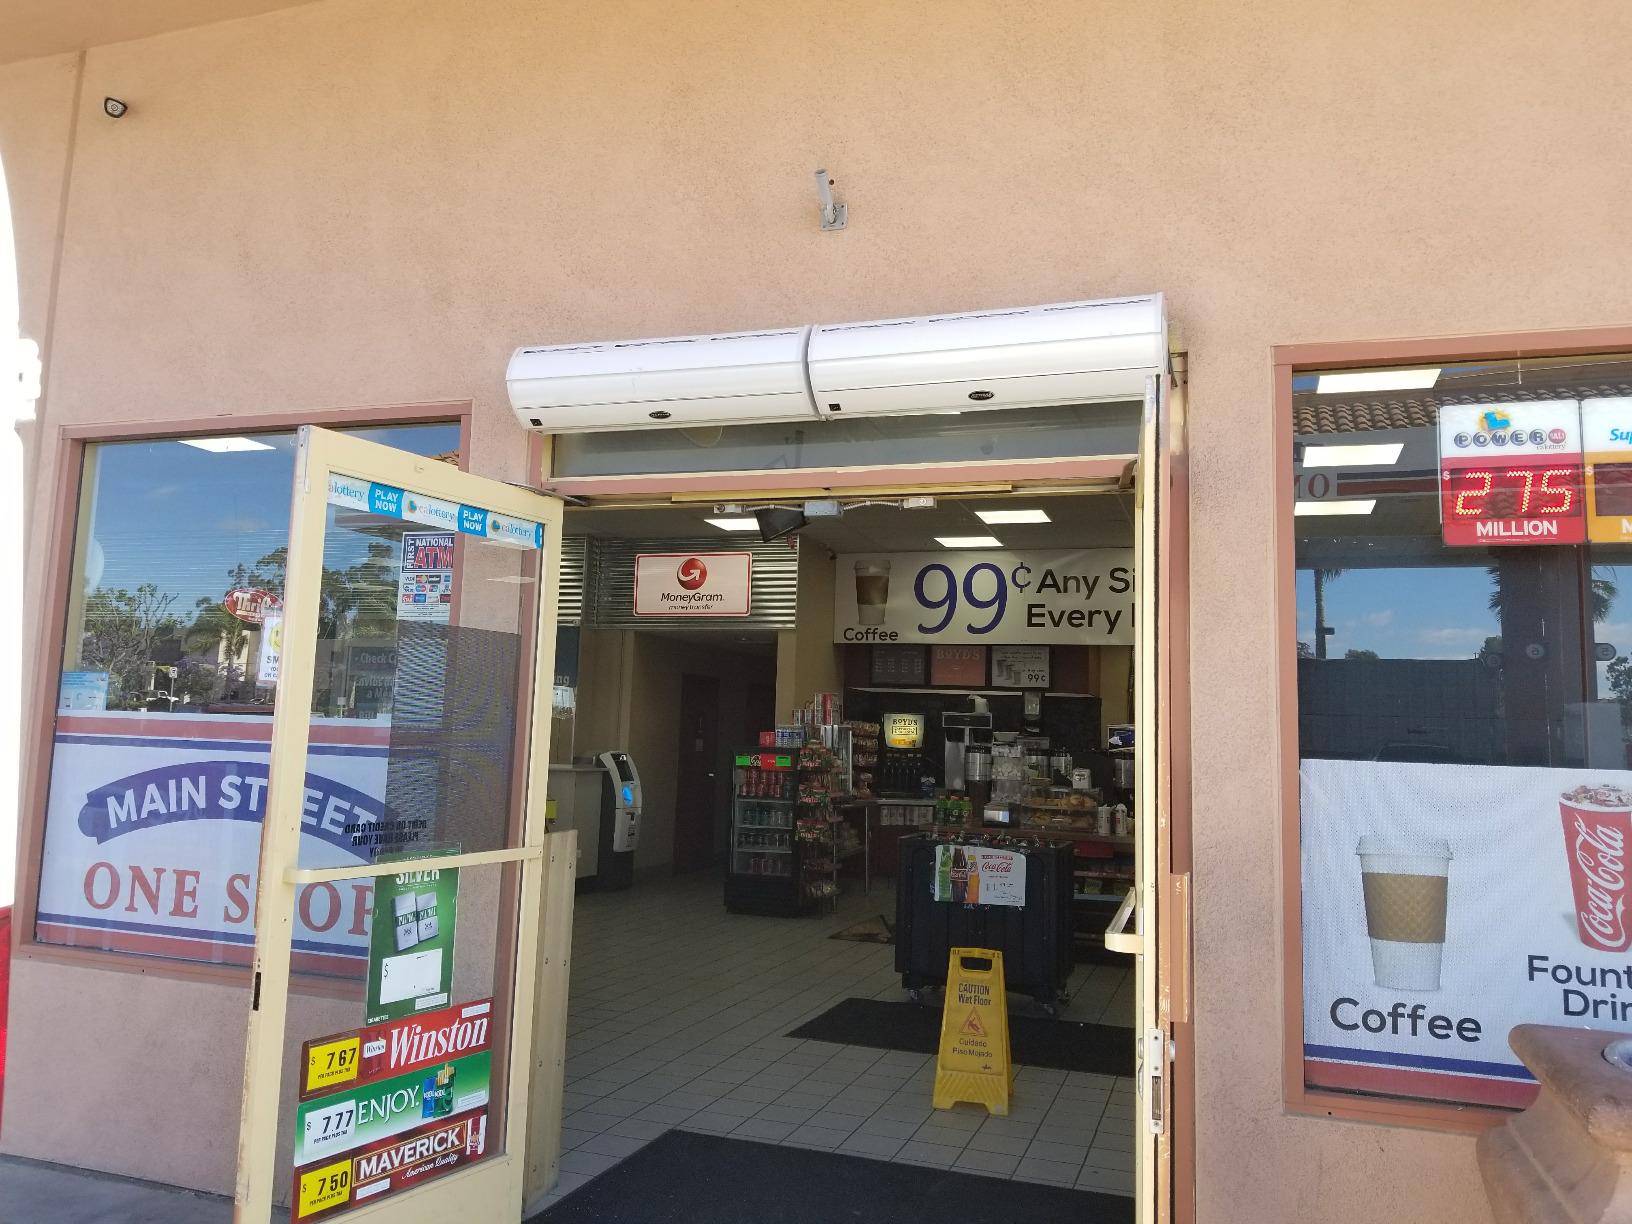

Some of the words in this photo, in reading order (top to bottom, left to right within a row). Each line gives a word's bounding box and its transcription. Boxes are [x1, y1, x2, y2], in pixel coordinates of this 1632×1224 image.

[328, 480, 365, 501] alottery
[375, 488, 399, 503] PLAY
[1456, 468, 1572, 515] 275
[375, 499, 398, 513] NOW
[463, 510, 484, 522] PLAY
[463, 520, 483, 532] NOW
[1476, 520, 1558, 537] MILLION
[416, 537, 453, 547] NATIONAL
[406, 538, 415, 569] FIRST
[413, 546, 453, 569] ATM
[1036, 568, 1100, 600] Any
[1108, 567, 1135, 594] Si
[660, 592, 723, 604] MoneyGram
[1027, 603, 1123, 635] Every
[843, 627, 899, 642] Coffee
[106, 775, 206, 829] MAIN
[218, 775, 377, 843] STEET
[395, 868, 440, 885] SILVER
[84, 862, 200, 918] ONE
[223, 874, 375, 937] SOP
[958, 983, 990, 995] CAUTION
[958, 993, 973, 1005] Wet
[973, 995, 992, 1006] Floor
[1329, 997, 1482, 1043] Coffee
[390, 1017, 488, 1069] Winston
[359, 1128, 460, 1180] MAVERICK
[401, 1163, 434, 1180] American
[435, 1152, 458, 1168] Quality
